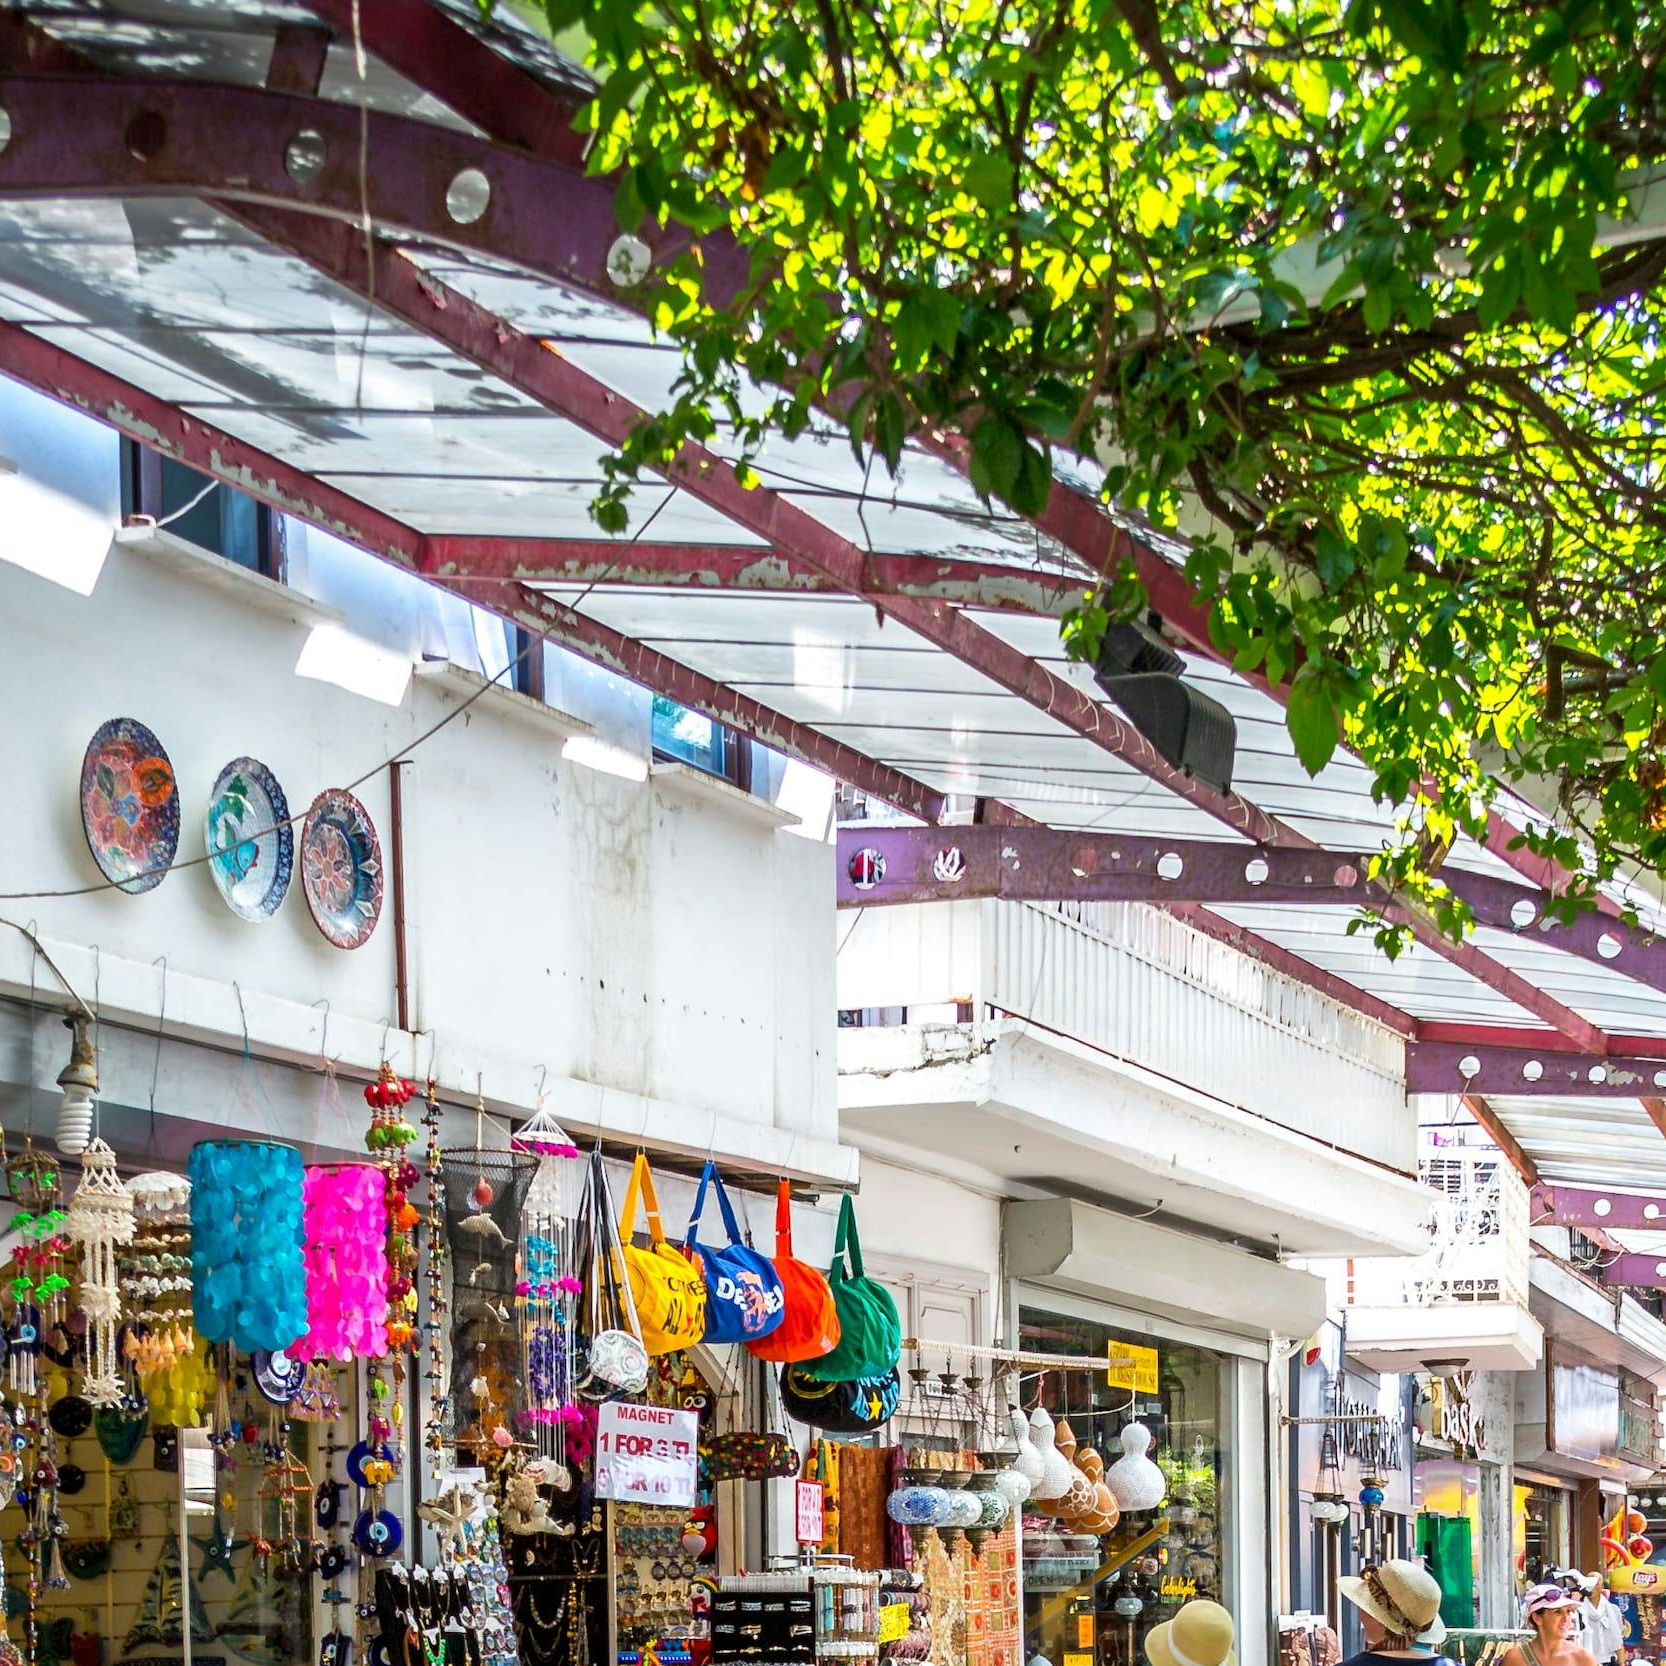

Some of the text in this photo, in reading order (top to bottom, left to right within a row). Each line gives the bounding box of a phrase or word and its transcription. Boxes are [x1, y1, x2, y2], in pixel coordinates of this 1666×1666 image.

[617, 1406, 675, 1425] MAGNET
[600, 1432, 609, 1453] 1
[615, 1434, 653, 1458] FOR
